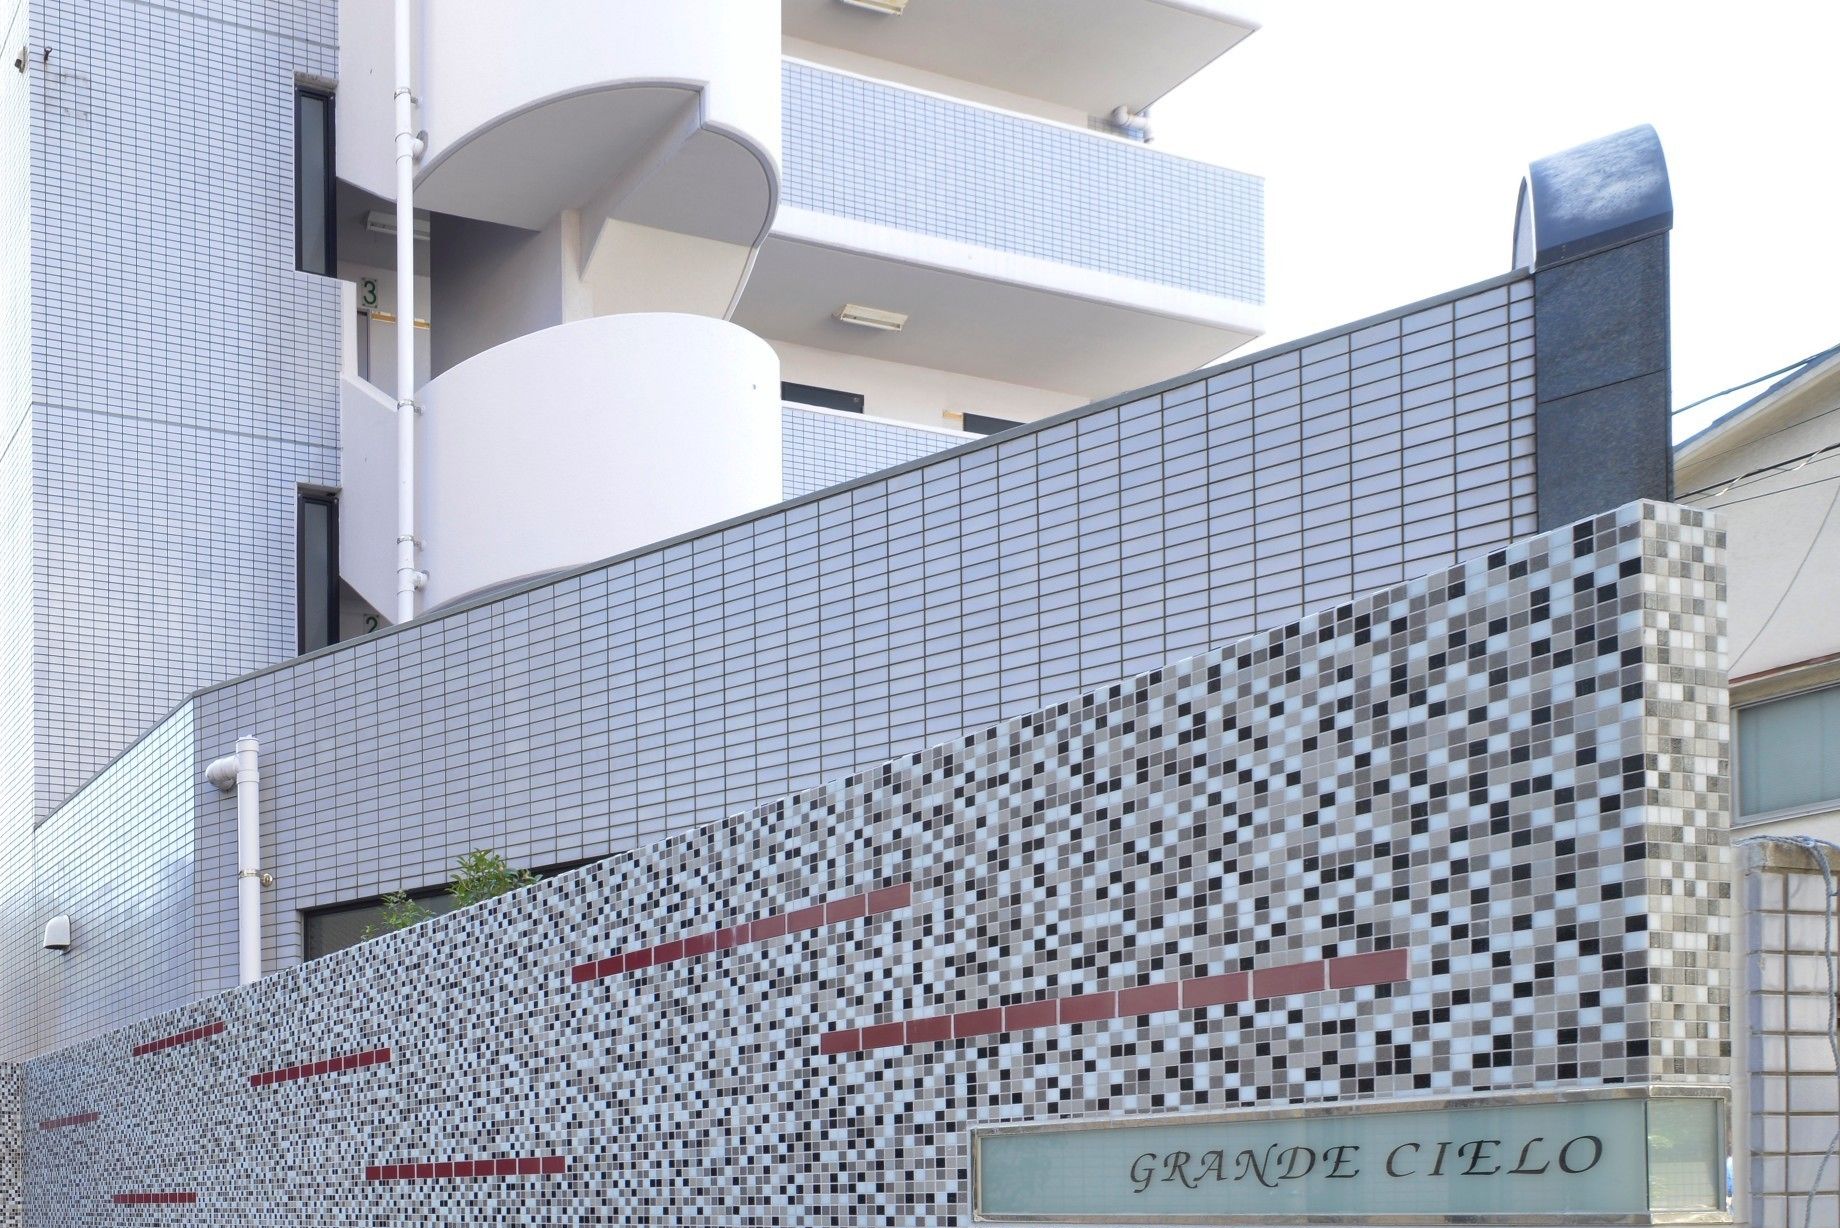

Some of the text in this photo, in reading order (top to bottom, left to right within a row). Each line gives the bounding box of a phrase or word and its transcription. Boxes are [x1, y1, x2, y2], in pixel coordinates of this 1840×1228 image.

[363, 280, 377, 305] 3
[1130, 1135, 1604, 1193] GRANDE CIELO
